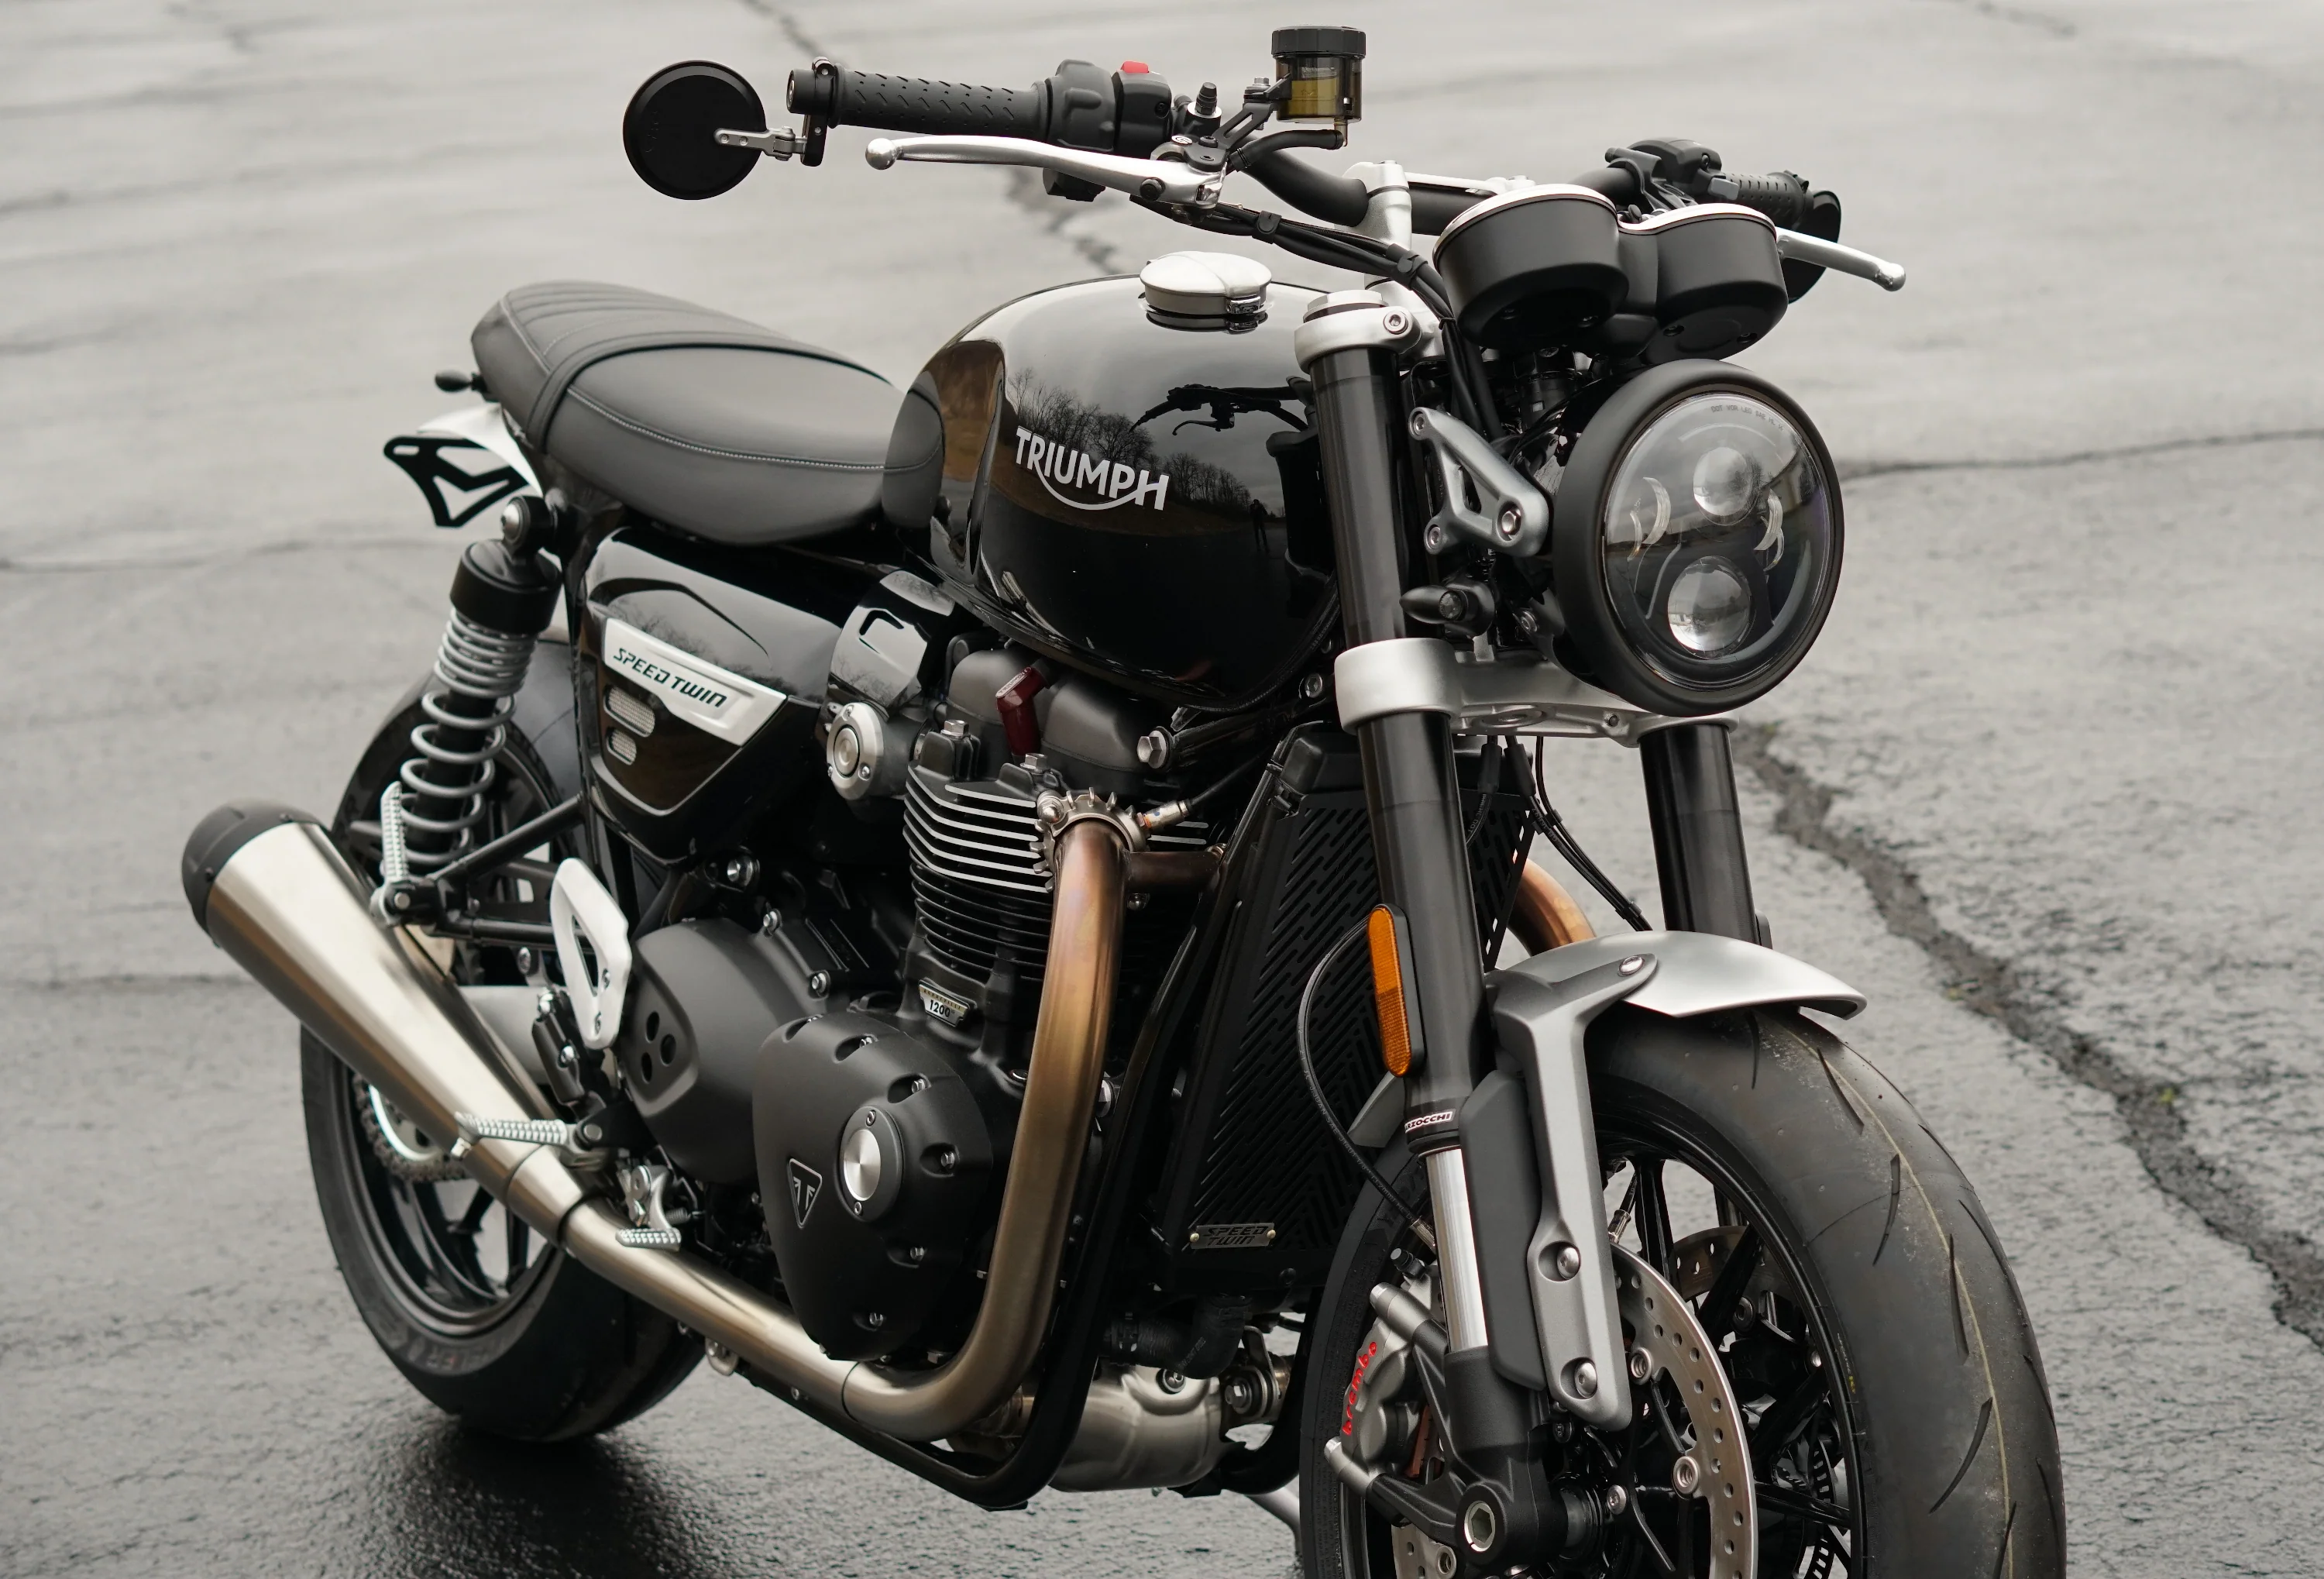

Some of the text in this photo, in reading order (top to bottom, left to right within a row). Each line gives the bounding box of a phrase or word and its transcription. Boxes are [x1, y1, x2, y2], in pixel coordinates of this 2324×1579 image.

[1016, 425, 1170, 511] TRIUMPH
[613, 647, 727, 708] SPEED TWIN
[930, 999, 951, 1018] 1200
[1326, 1116, 1338, 1135] SAE
[1203, 1226, 1269, 1237] SPEED
[1206, 1235, 1256, 1246] TWIN
